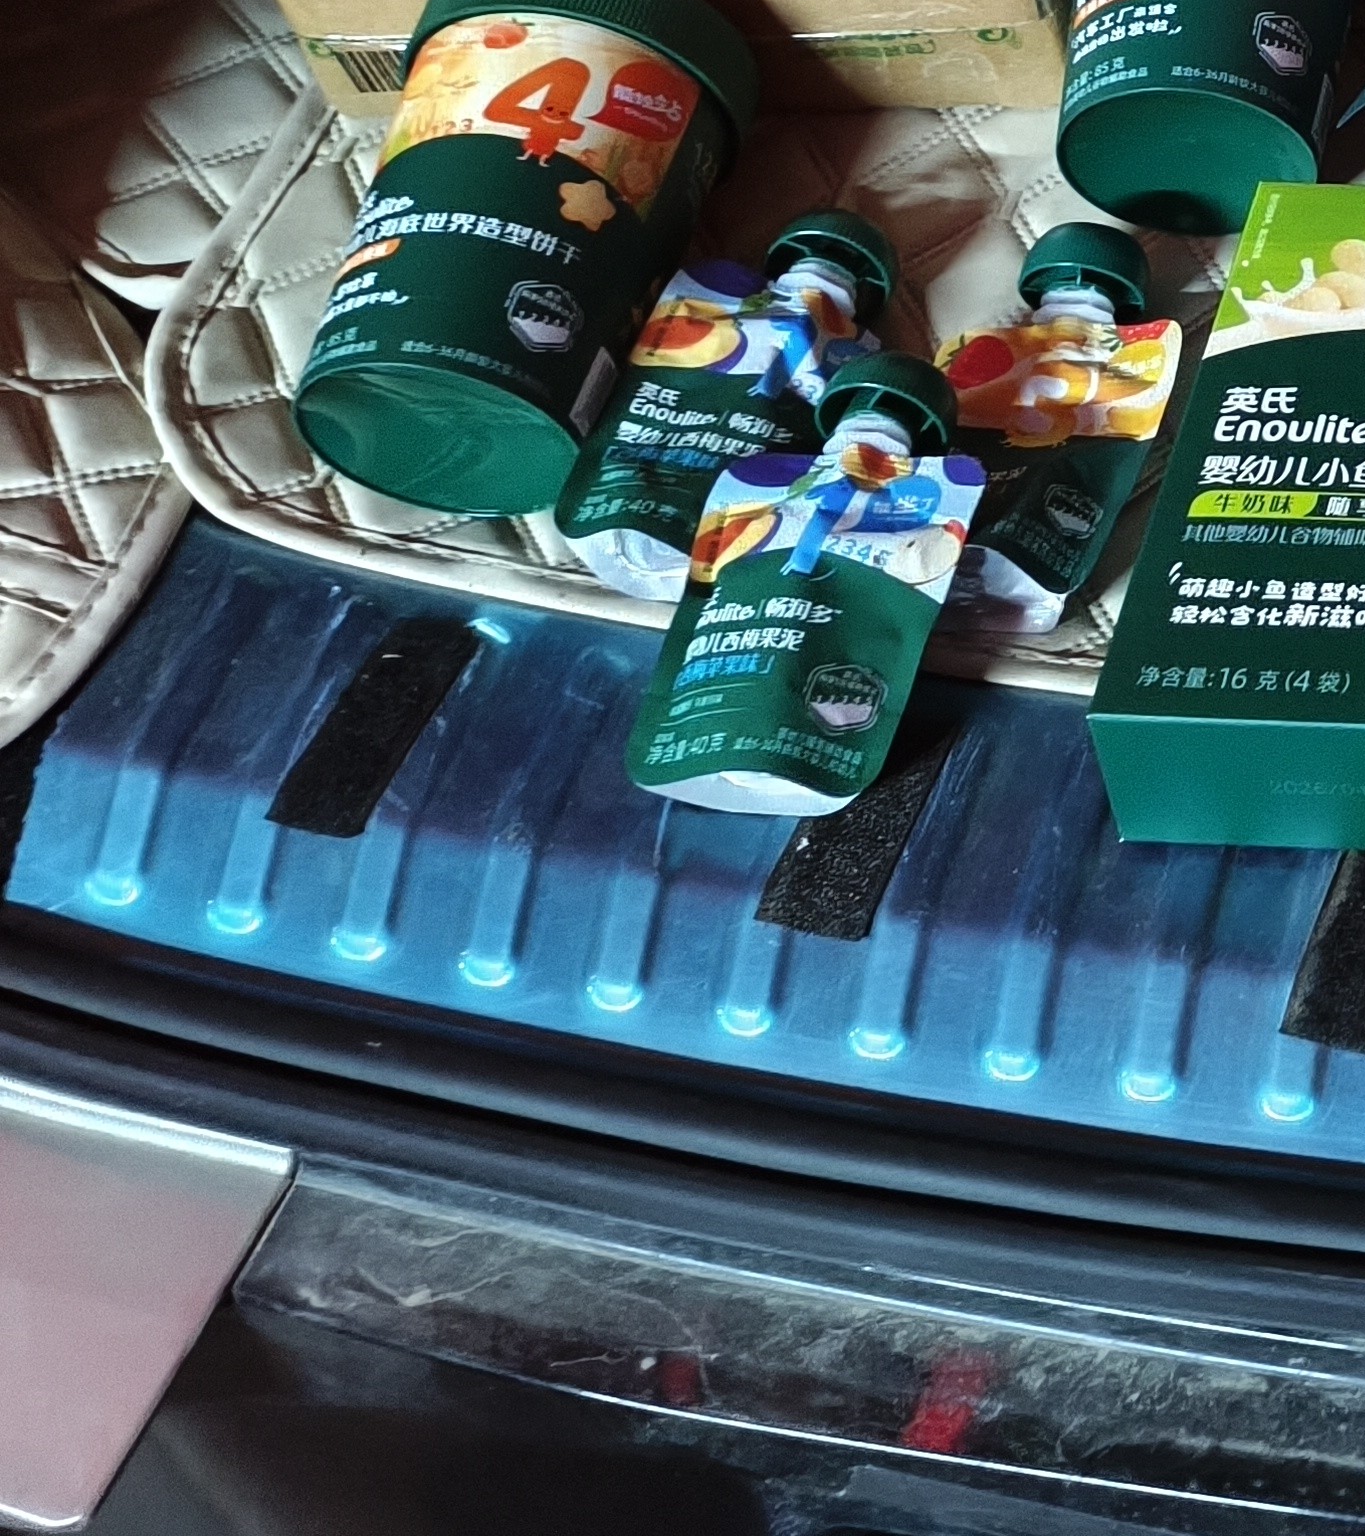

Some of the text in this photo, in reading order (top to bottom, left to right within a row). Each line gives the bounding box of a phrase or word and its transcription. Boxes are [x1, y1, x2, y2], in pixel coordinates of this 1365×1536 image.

[483, 56, 586, 166] 4
[1219, 386, 1299, 415] 英氏
[1213, 492, 1295, 515] 牛奶味
